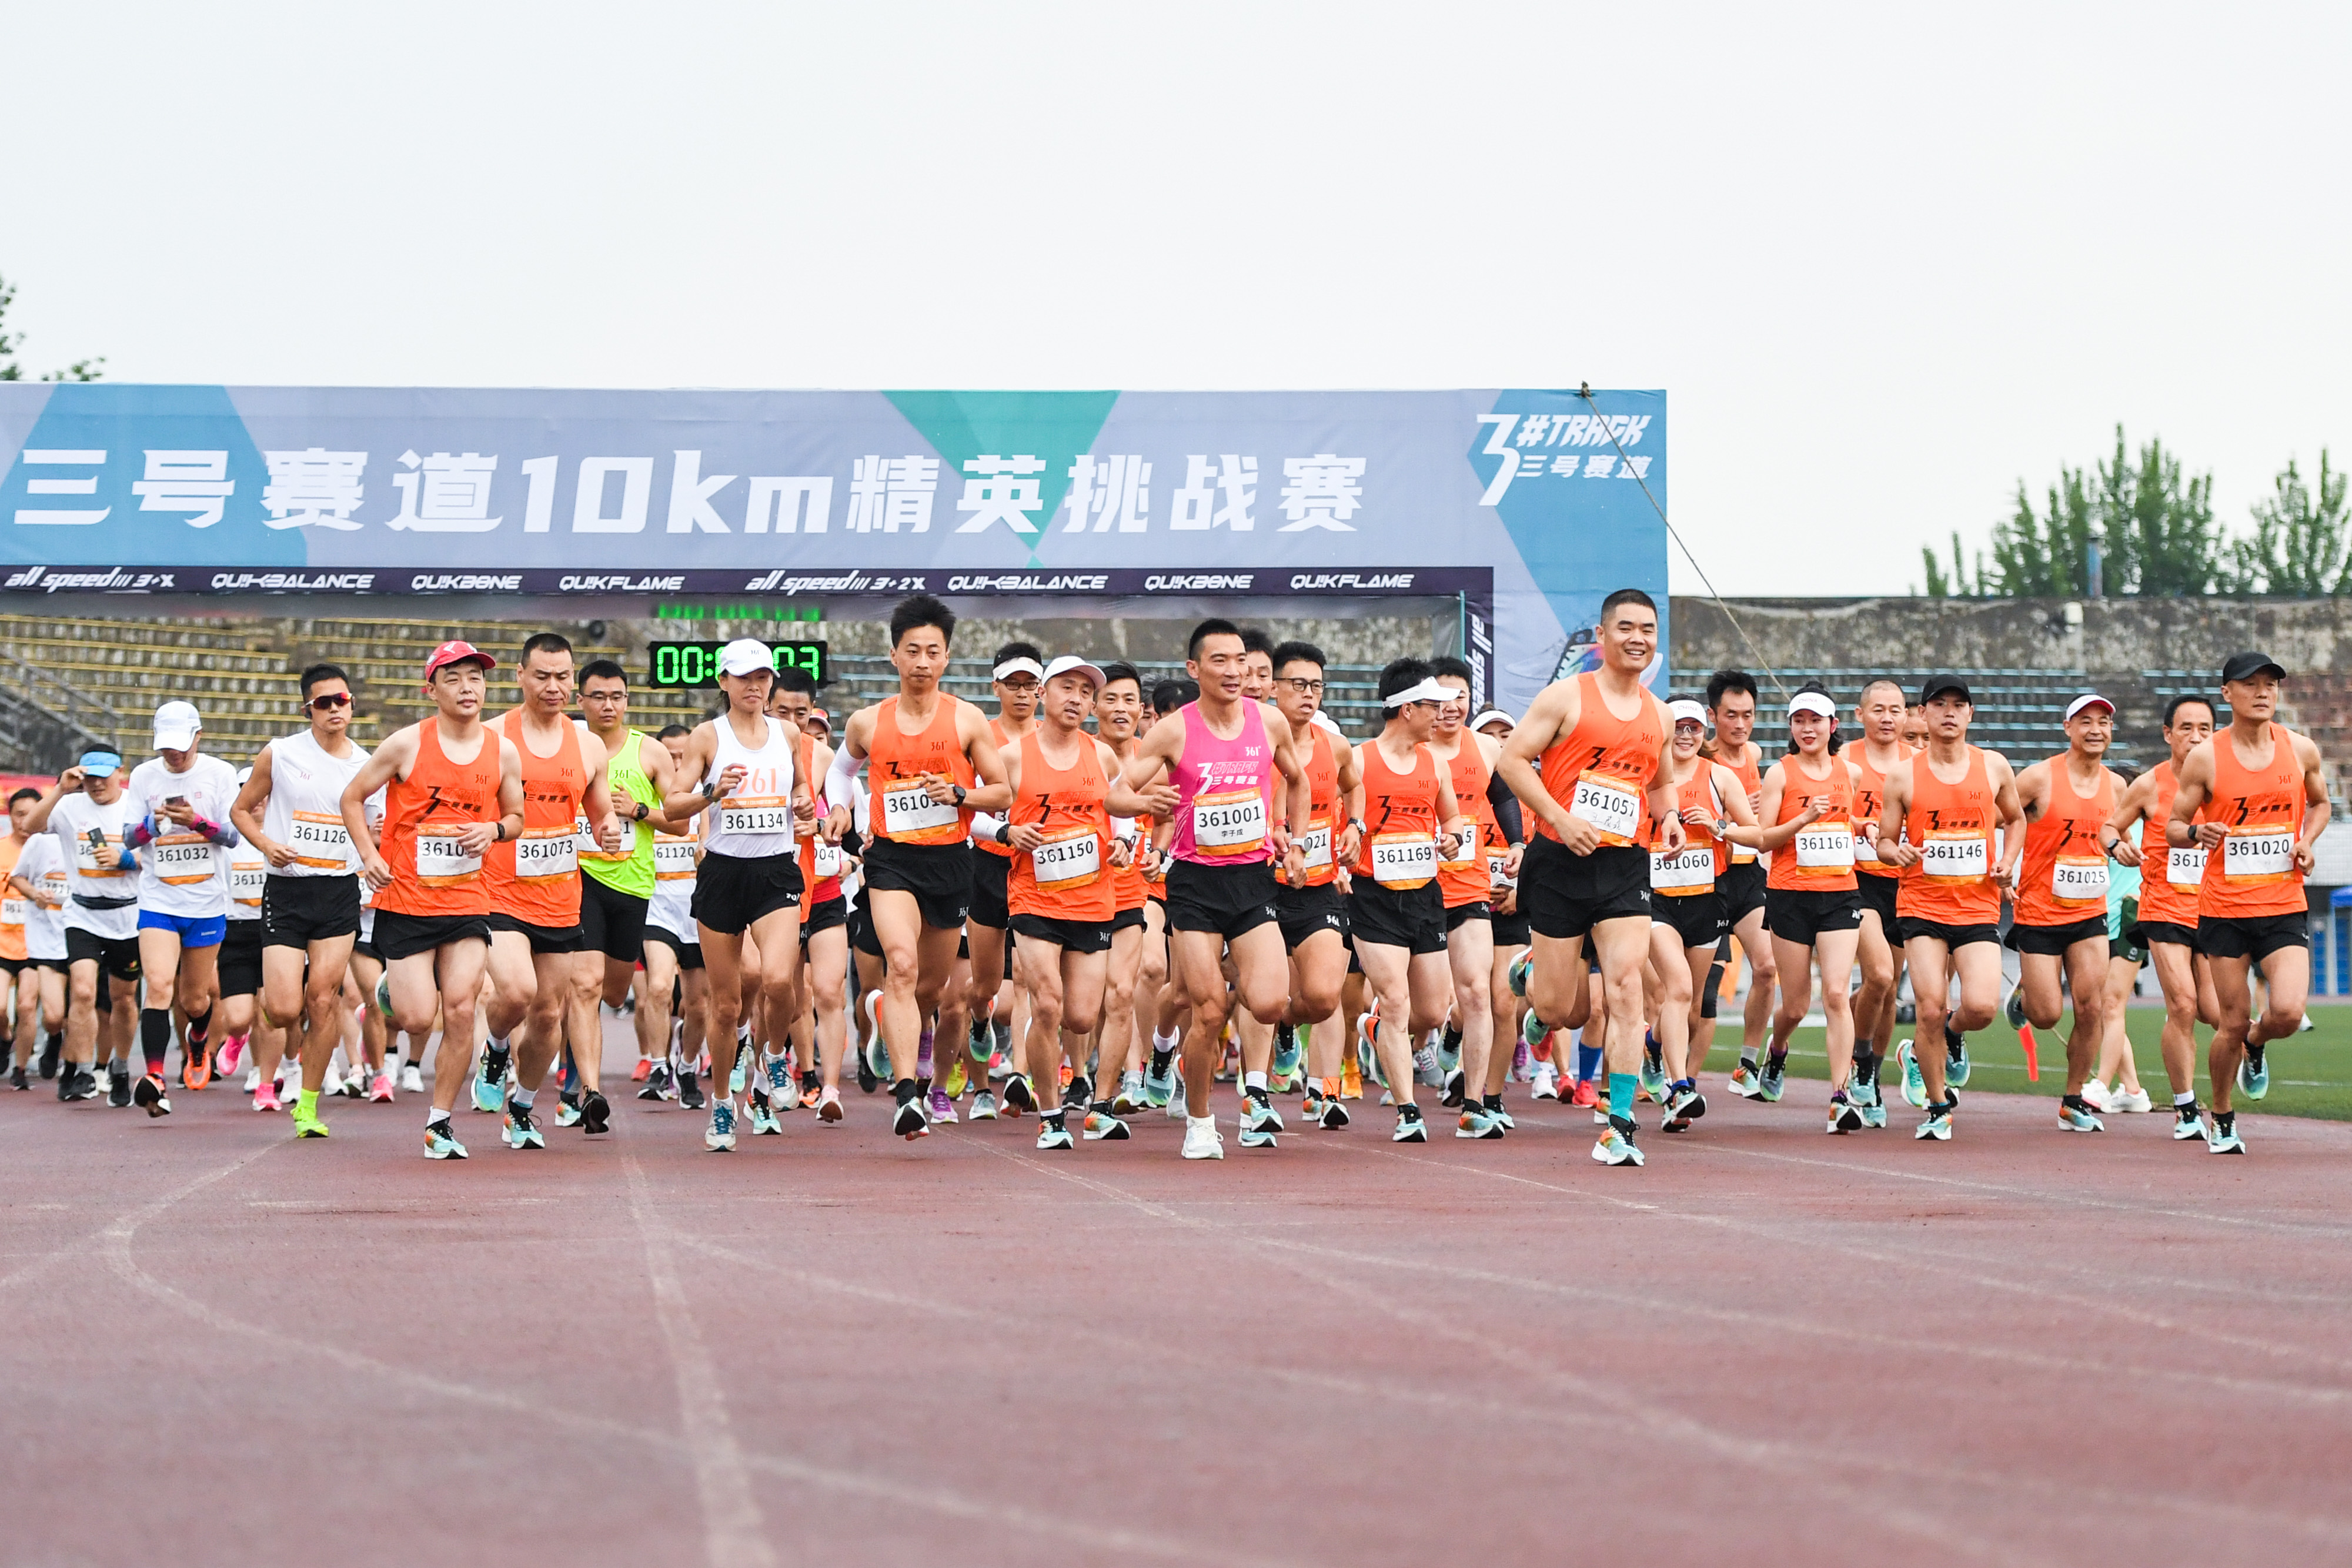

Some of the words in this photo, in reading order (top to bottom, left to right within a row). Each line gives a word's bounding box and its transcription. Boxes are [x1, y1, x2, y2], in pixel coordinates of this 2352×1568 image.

[1516, 454, 1653, 479] 三号赛道
[14, 447, 1367, 533] 三号赛道10km精英挑战赛
[4, 566, 47, 587] all
[745, 570, 786, 590] all
[1578, 788, 1635, 817] 361057
[726, 813, 783, 830] 361134
[1198, 805, 1261, 828] 361001
[293, 825, 347, 844] 361126
[422, 842, 468, 857] 3610
[520, 840, 573, 858] 361073
[654, 847, 694, 858] 61120
[1037, 840, 1093, 864] 361150
[1800, 837, 1849, 851] 361167
[1927, 844, 1982, 859] 361146
[2229, 839, 2290, 856] 361020
[157, 847, 209, 862] 361032
[1377, 847, 1432, 864] 361169
[1654, 854, 1709, 871] 361060
[2057, 870, 2106, 884] 361025
